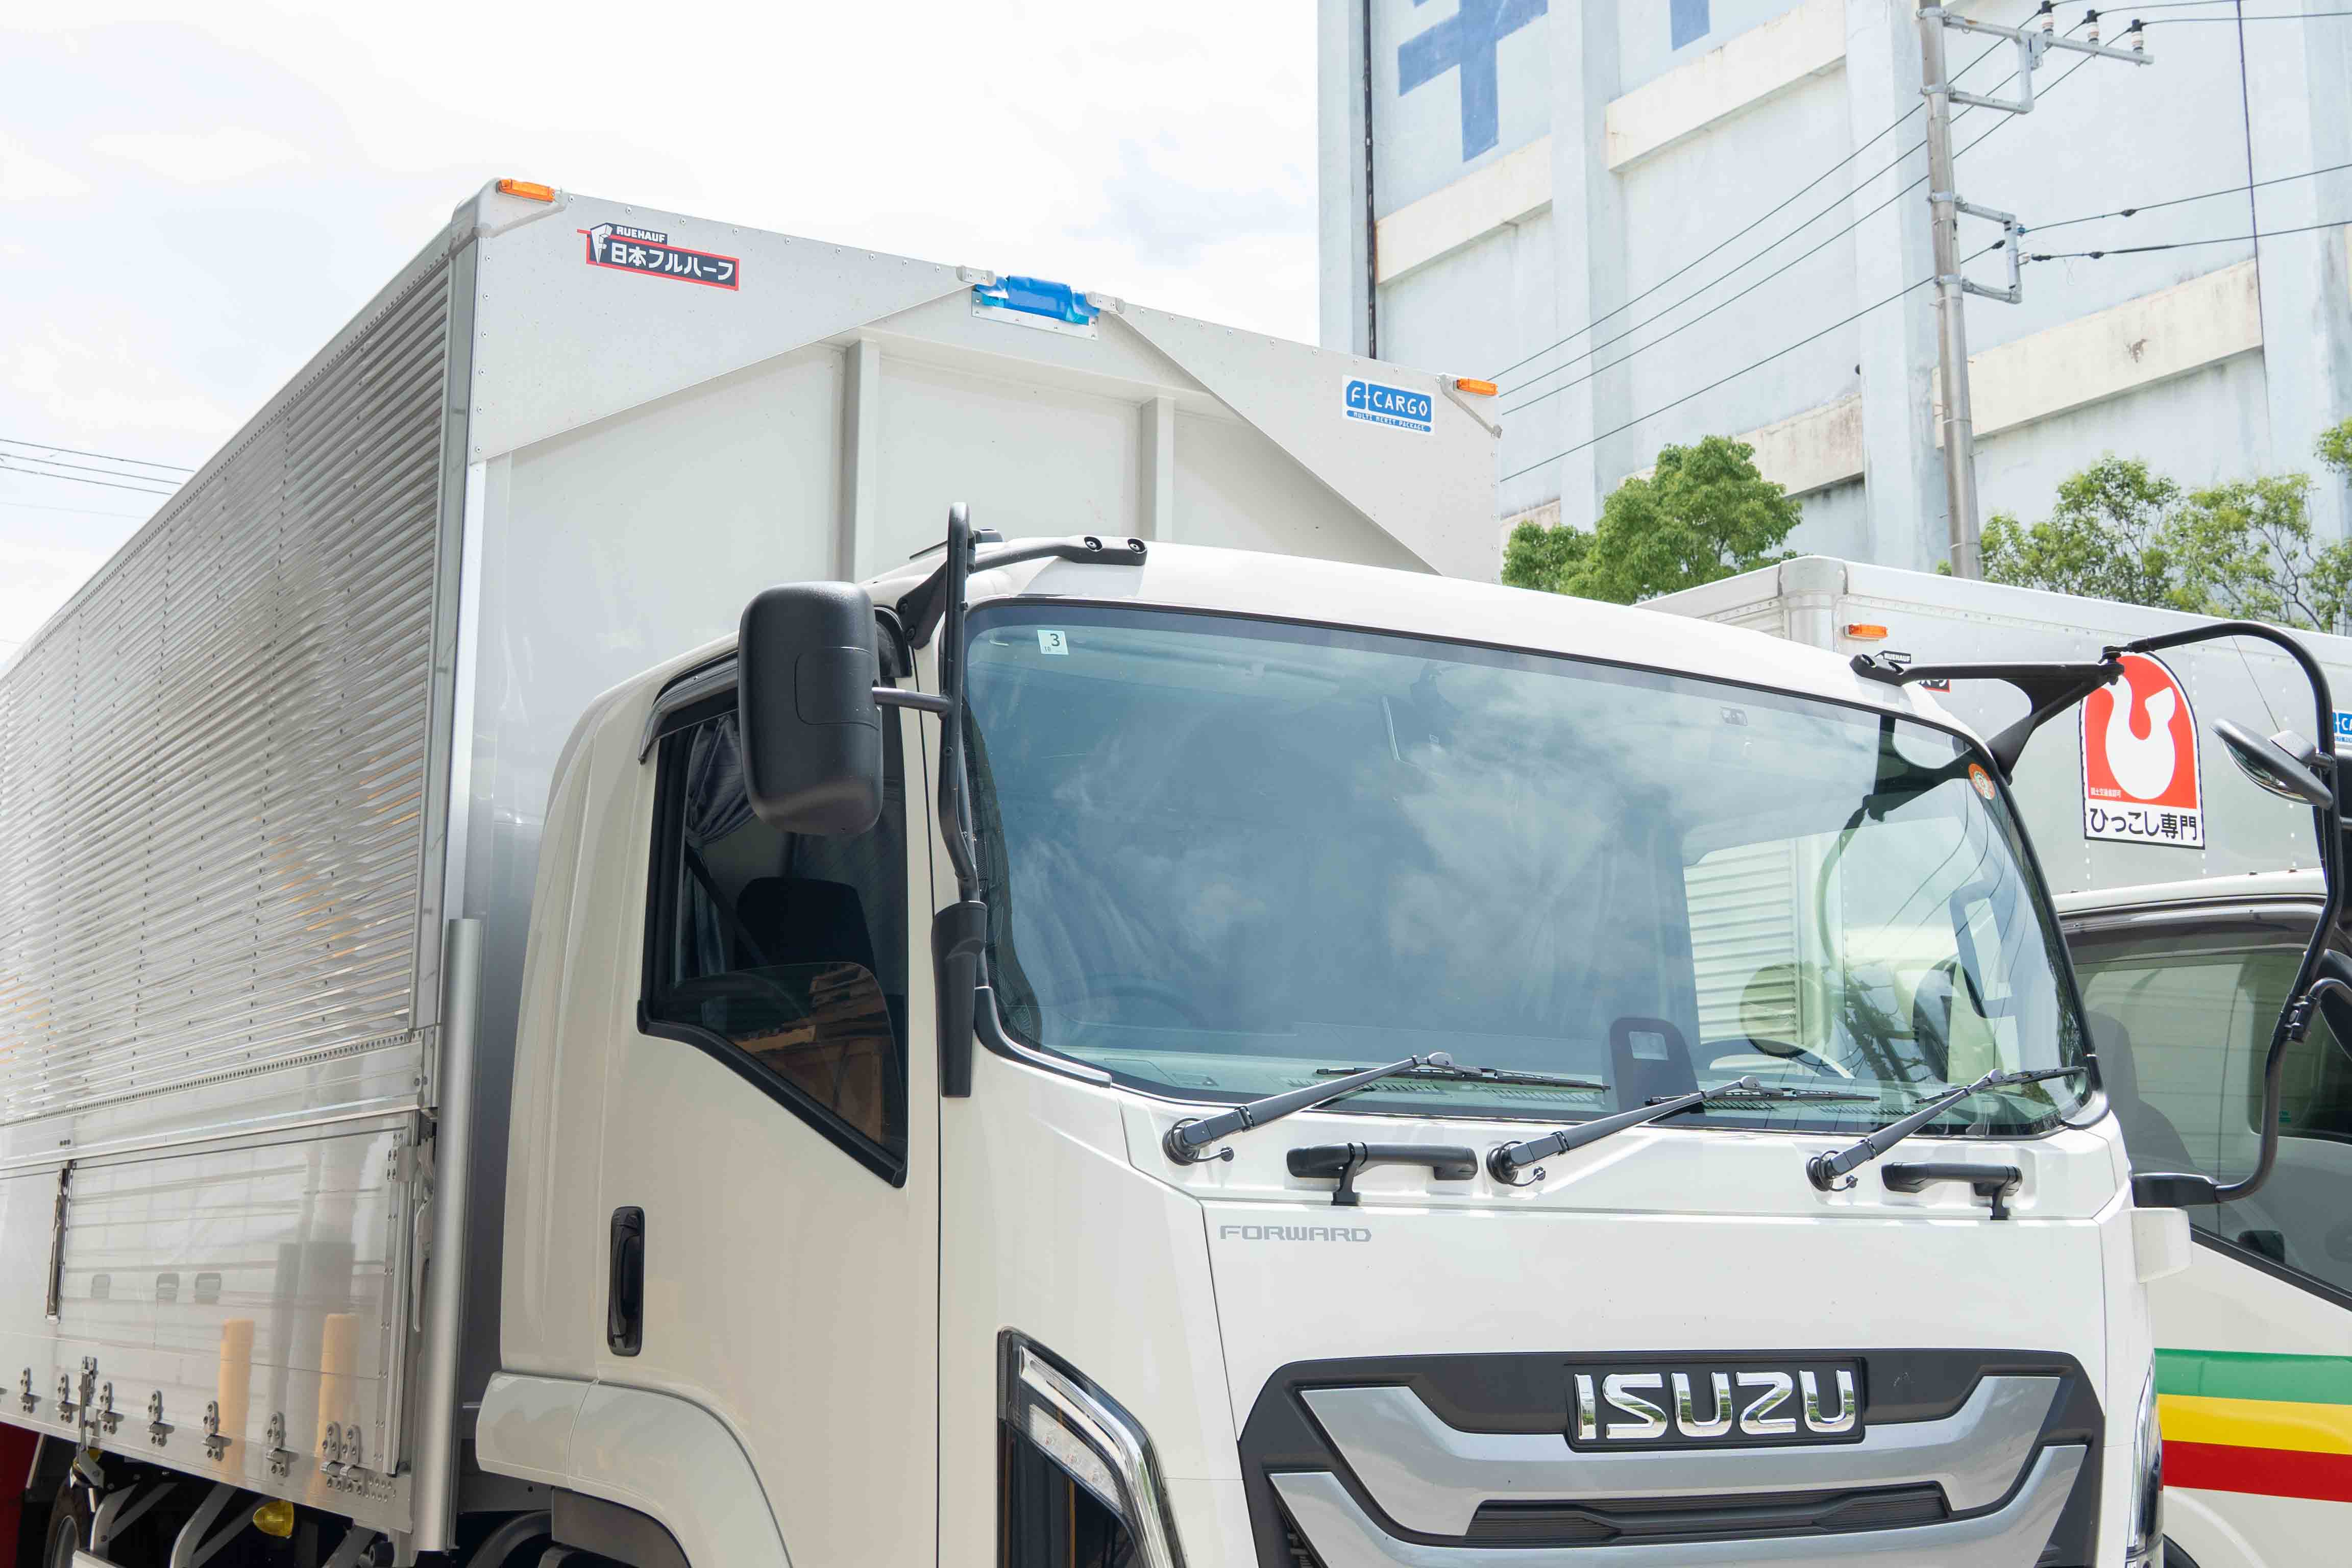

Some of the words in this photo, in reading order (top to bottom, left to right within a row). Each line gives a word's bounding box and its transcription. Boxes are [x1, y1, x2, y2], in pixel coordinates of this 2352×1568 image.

[611, 242, 733, 280] 日本フルハーフ
[1354, 412, 1373, 421] MULTI
[1399, 421, 1426, 431] PACKAGE
[1050, 633, 1060, 646] 3
[2090, 808, 2197, 841] ひっこし専門
[1219, 1225, 1372, 1242] FORWARD
[1574, 1369, 1856, 1440] ISUZU
